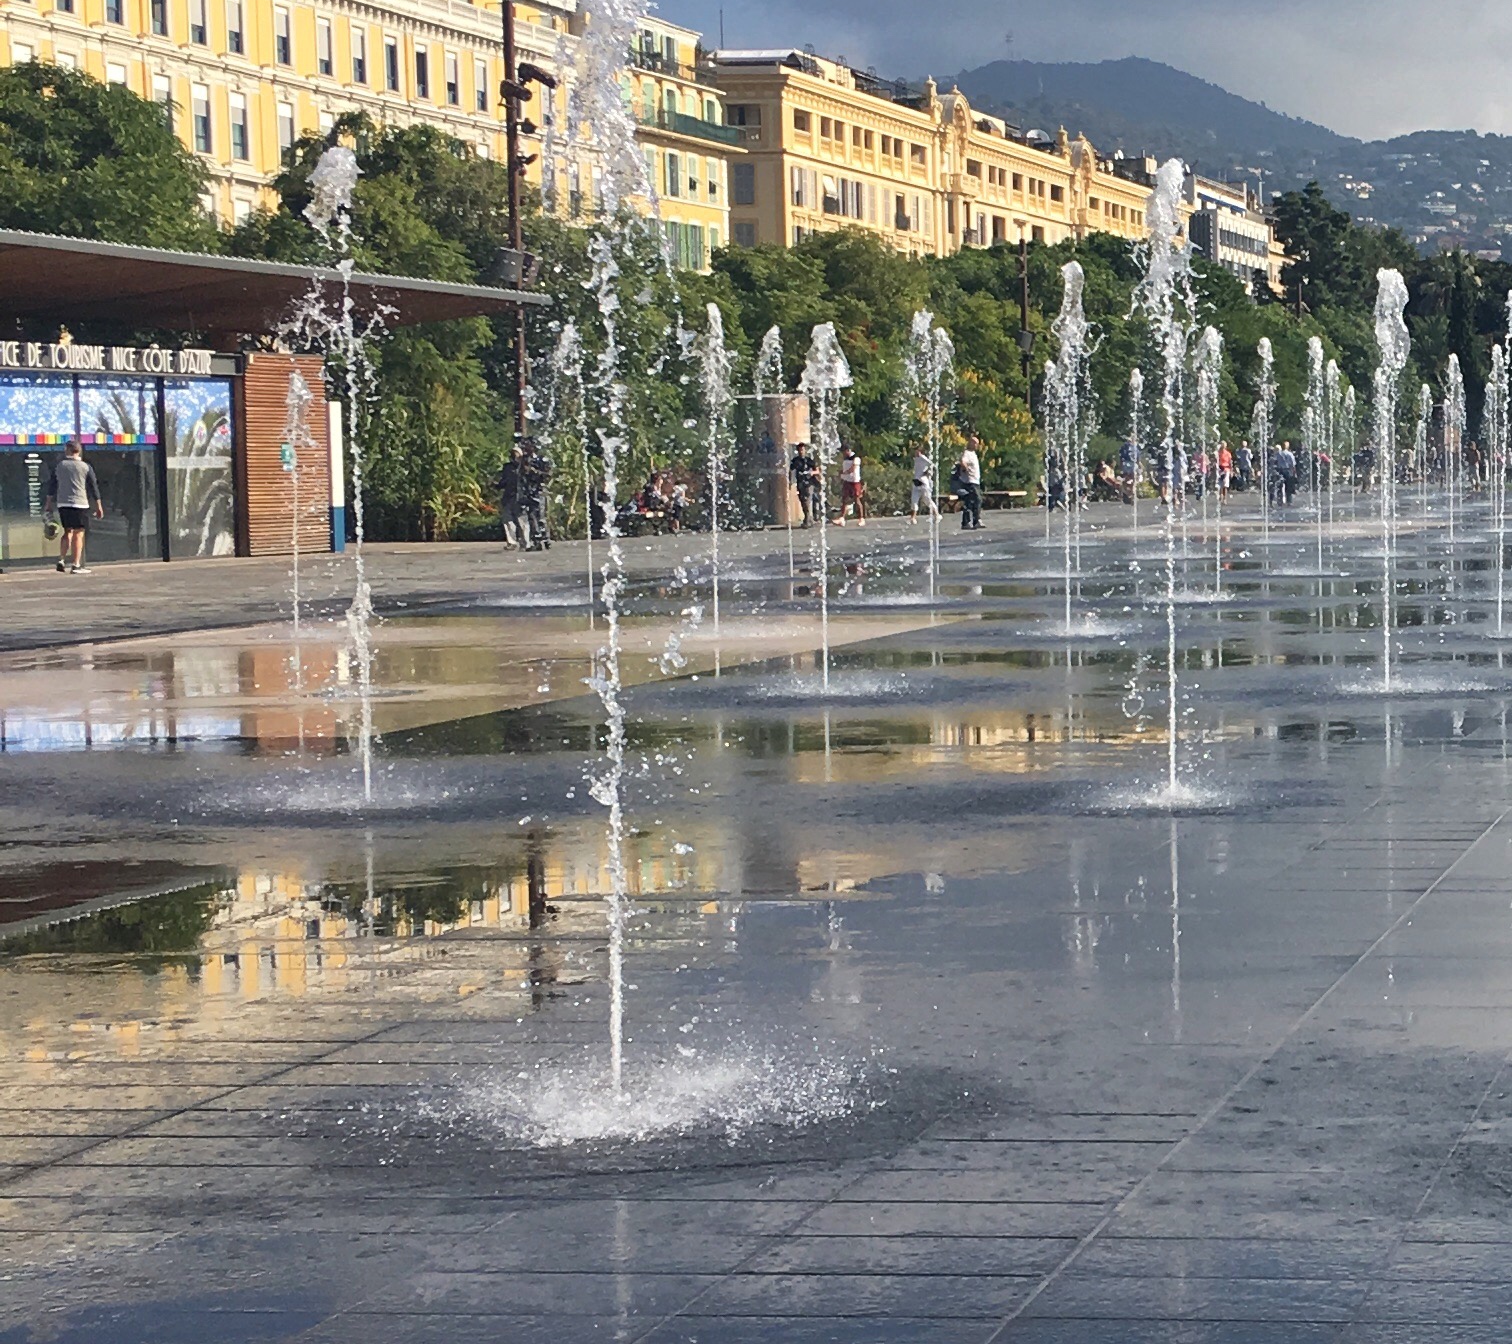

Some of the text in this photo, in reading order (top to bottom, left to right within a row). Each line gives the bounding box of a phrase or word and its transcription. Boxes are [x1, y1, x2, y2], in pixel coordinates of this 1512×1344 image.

[28, 342, 43, 367] DE
[49, 343, 106, 370] TOURISME
[112, 346, 136, 371] NICE
[143, 343, 174, 373] CÔTE
[179, 348, 216, 374] D'AZUR
